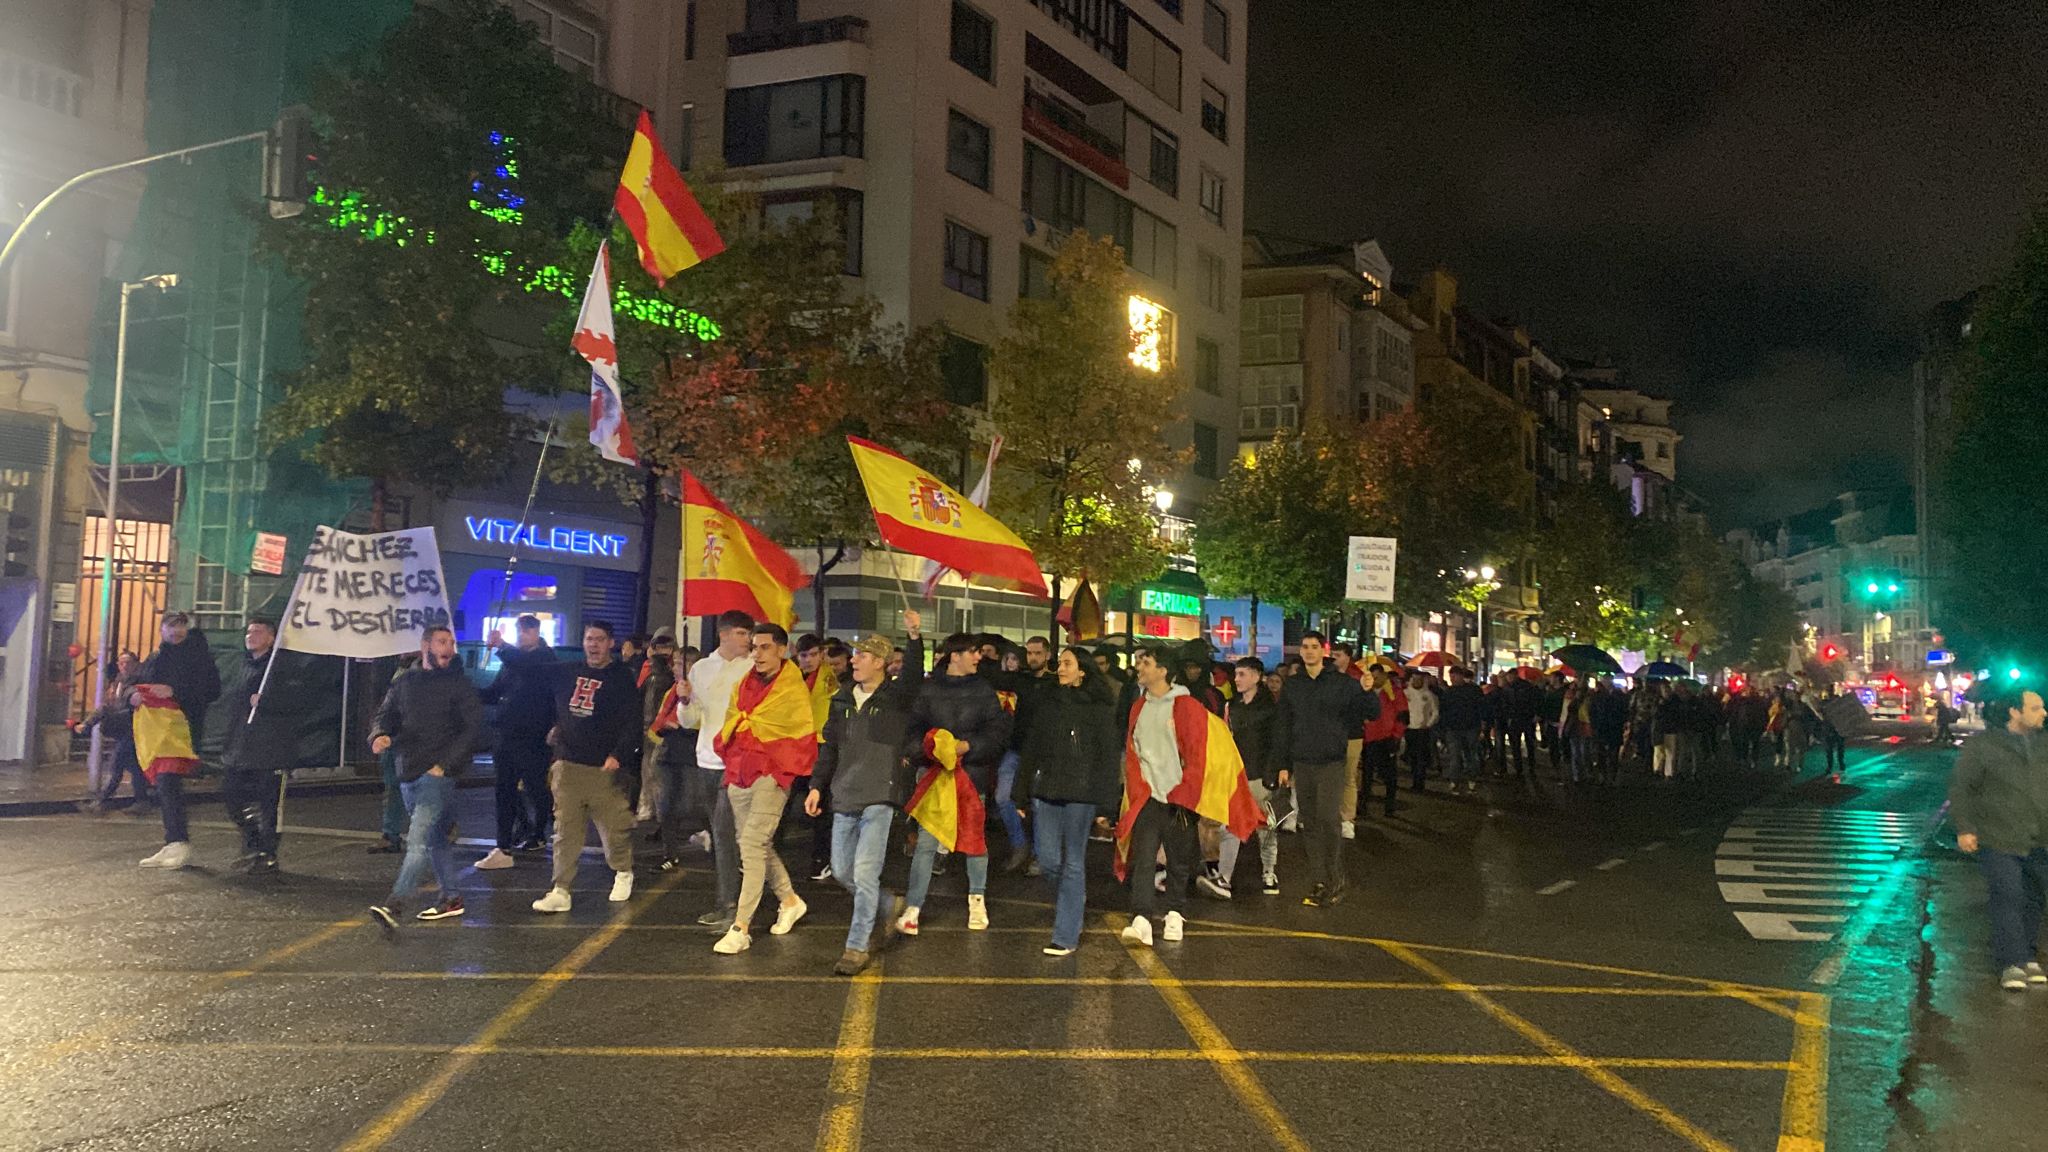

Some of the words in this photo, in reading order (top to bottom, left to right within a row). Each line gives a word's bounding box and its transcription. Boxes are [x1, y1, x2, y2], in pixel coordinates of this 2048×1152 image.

[465, 515, 628, 557] VITALDENT
[301, 565, 328, 594] TE
[334, 569, 441, 599] MERECES
[291, 600, 320, 629] EL
[569, 676, 603, 710] H
